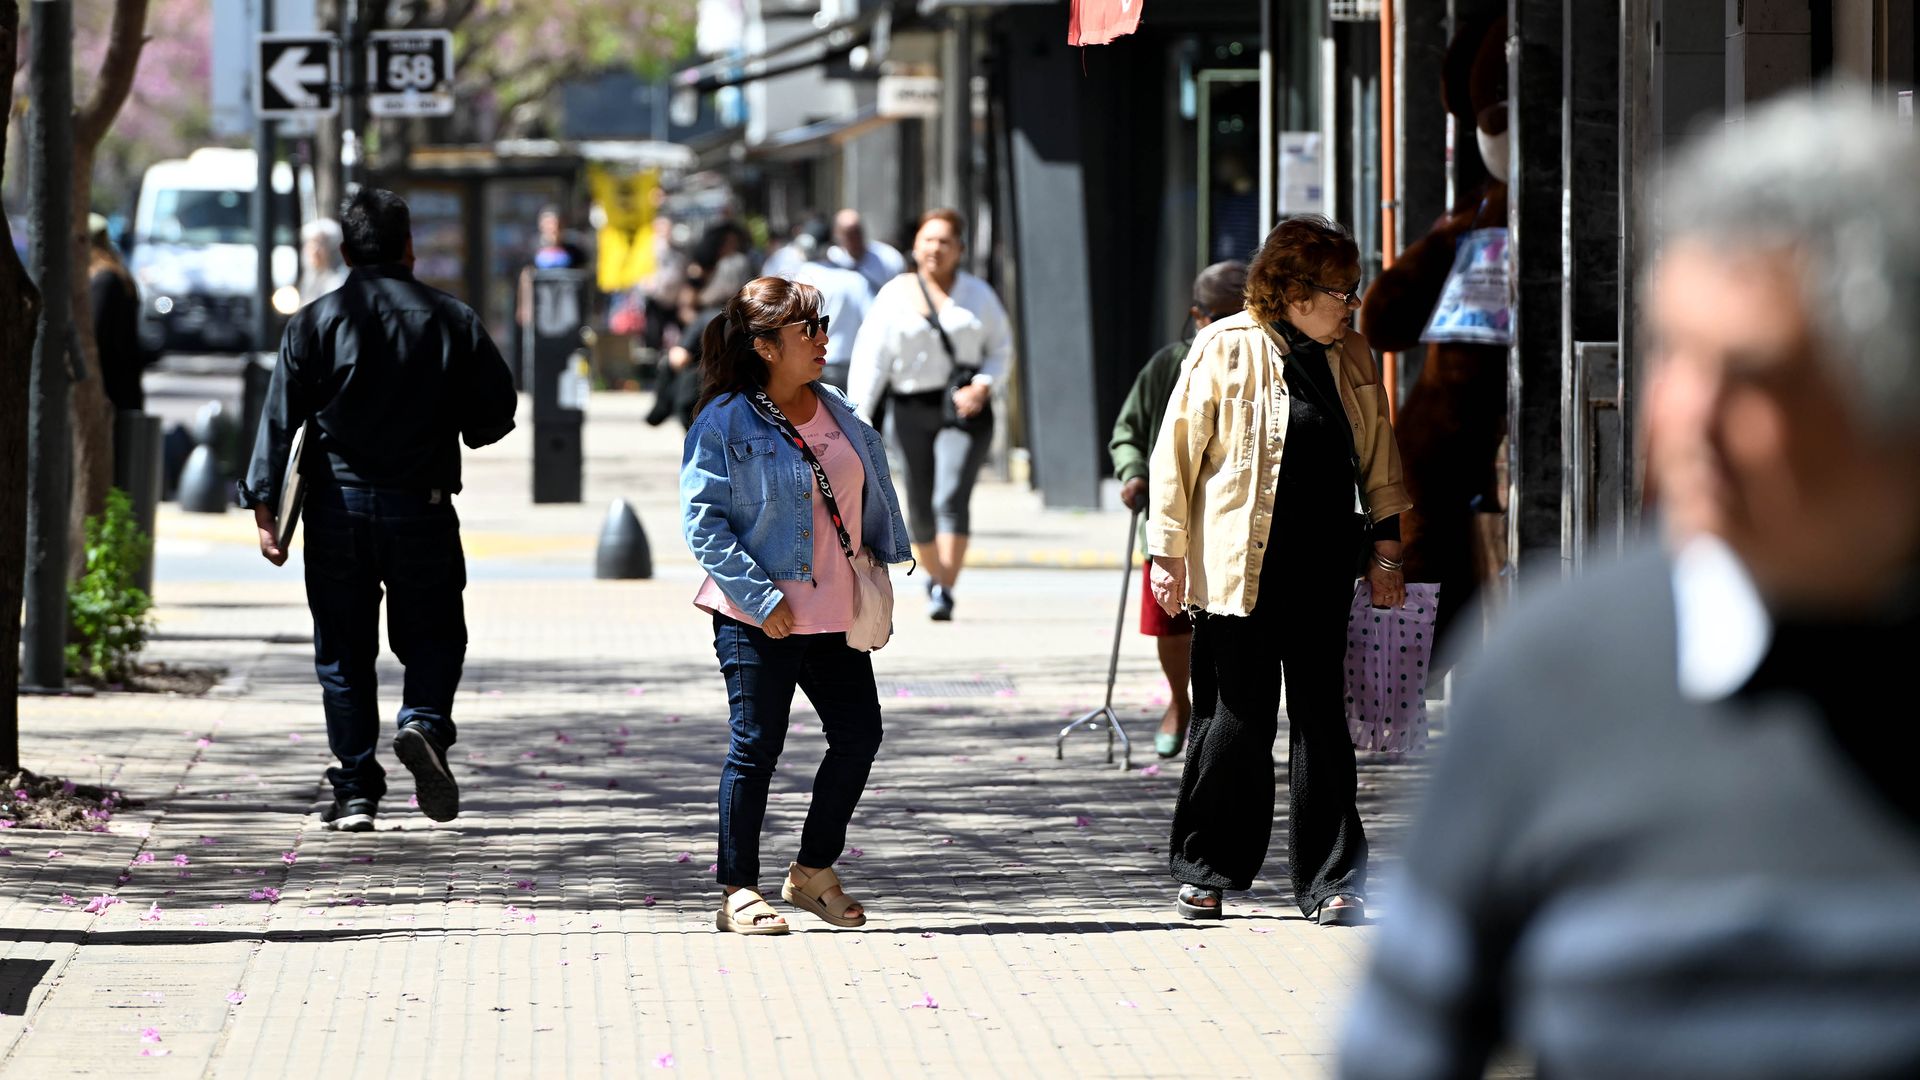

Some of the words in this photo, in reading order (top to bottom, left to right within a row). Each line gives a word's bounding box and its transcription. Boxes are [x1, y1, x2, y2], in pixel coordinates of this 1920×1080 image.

[388, 54, 434, 89] 58
[756, 391, 786, 420] Love
[813, 461, 833, 497] Love
